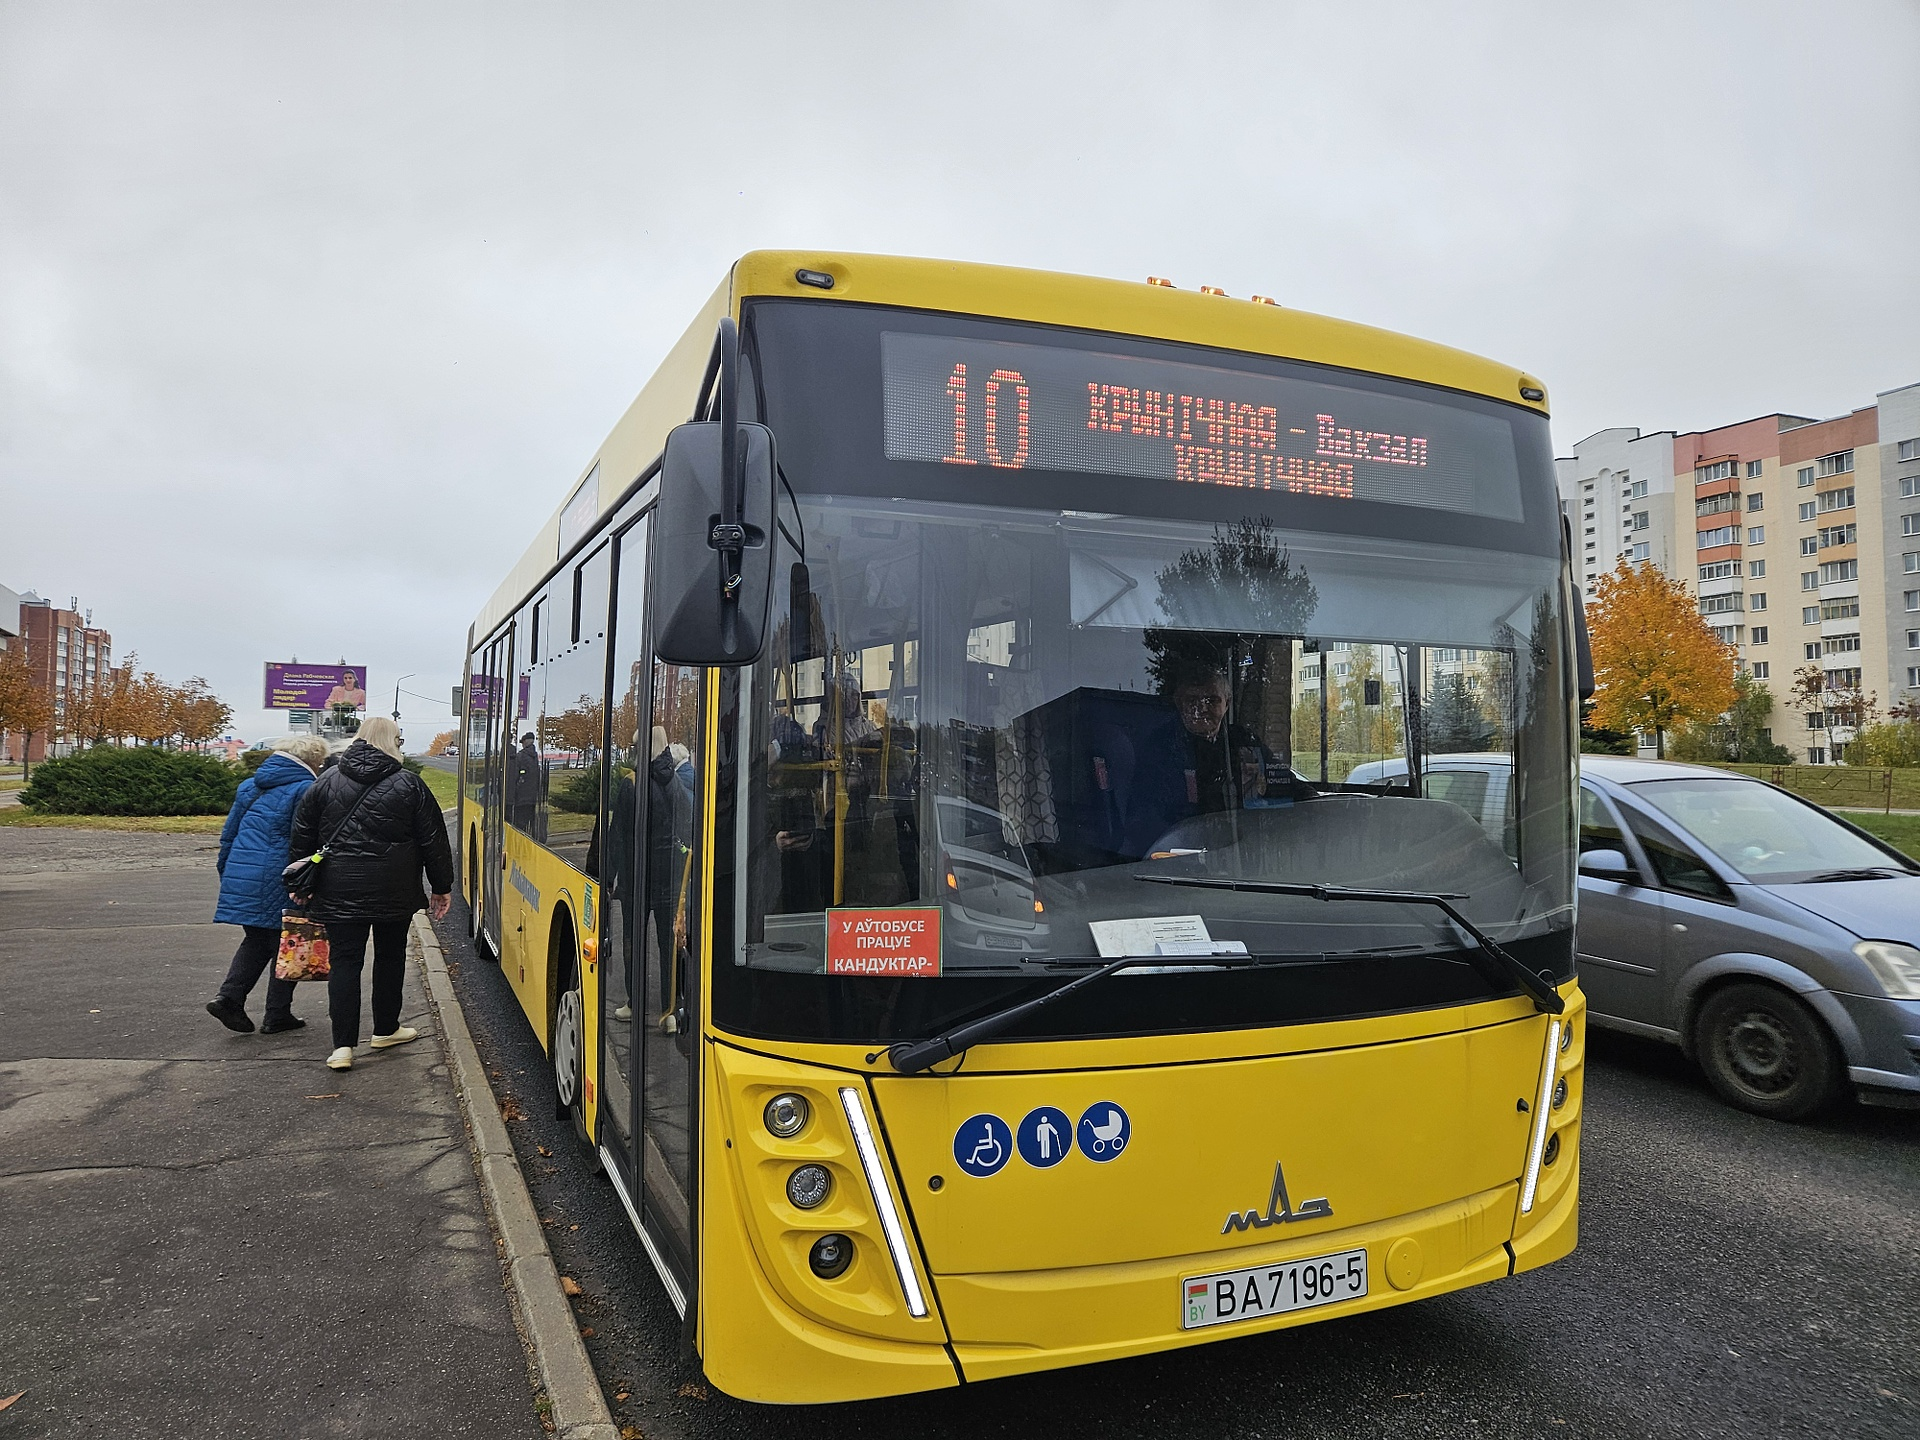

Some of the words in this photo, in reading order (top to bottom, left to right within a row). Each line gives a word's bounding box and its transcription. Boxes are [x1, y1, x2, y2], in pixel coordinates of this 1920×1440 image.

[943, 363, 1029, 468] 10
[1088, 382, 1277, 450] КРЫНІЧНАЯ
[1316, 413, 1427, 467] Вакзал
[843, 921, 853, 934] У
[855, 918, 925, 934] АЎТОБУСЕ
[856, 936, 911, 951] ПРАЦУЕ
[834, 956, 933, 974] КАНДУКТАР-
[1190, 1304, 1207, 1322] BY
